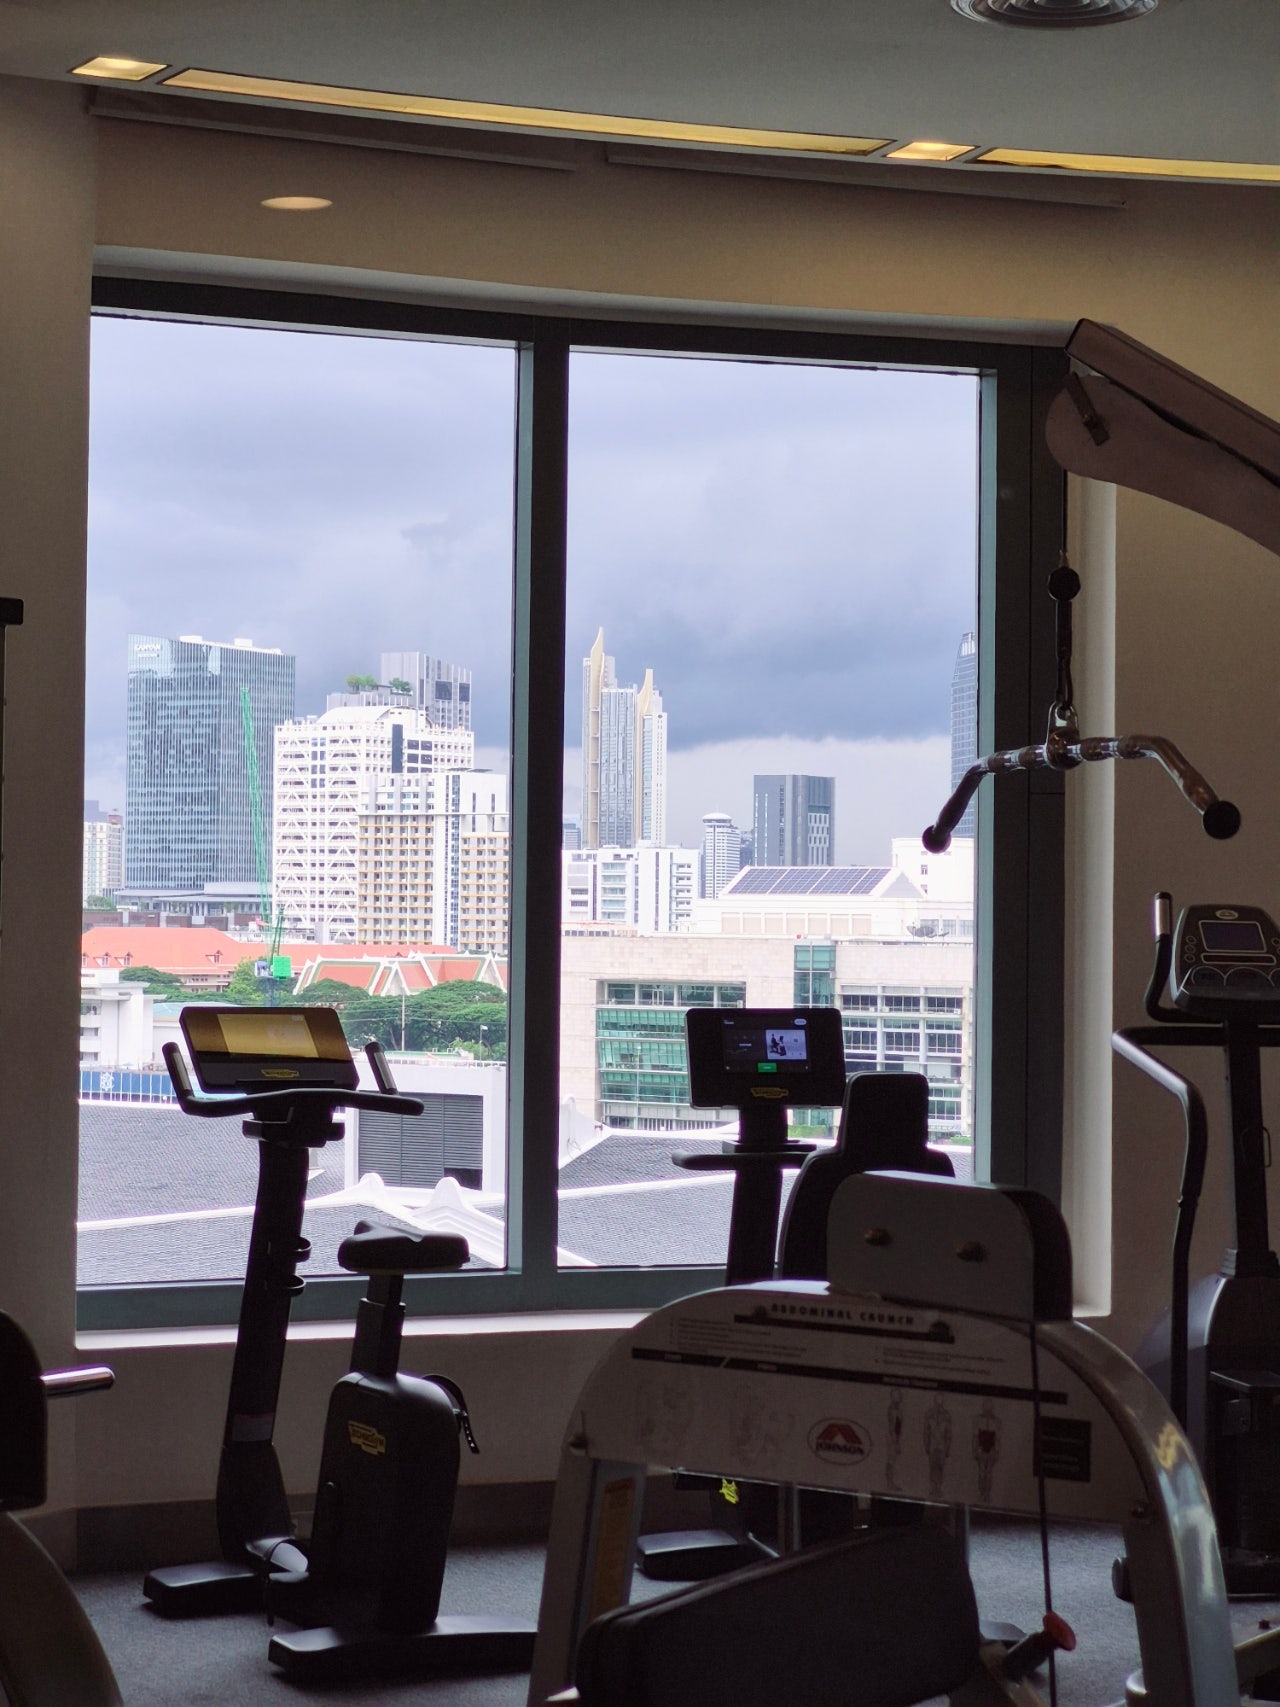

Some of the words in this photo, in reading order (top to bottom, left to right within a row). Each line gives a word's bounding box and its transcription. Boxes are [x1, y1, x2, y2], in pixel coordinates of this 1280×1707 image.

[771, 1303, 853, 1320] ABDOMINAL
[859, 1311, 914, 1326] CRUNCH
[816, 1441, 865, 1455] JOHNSON
